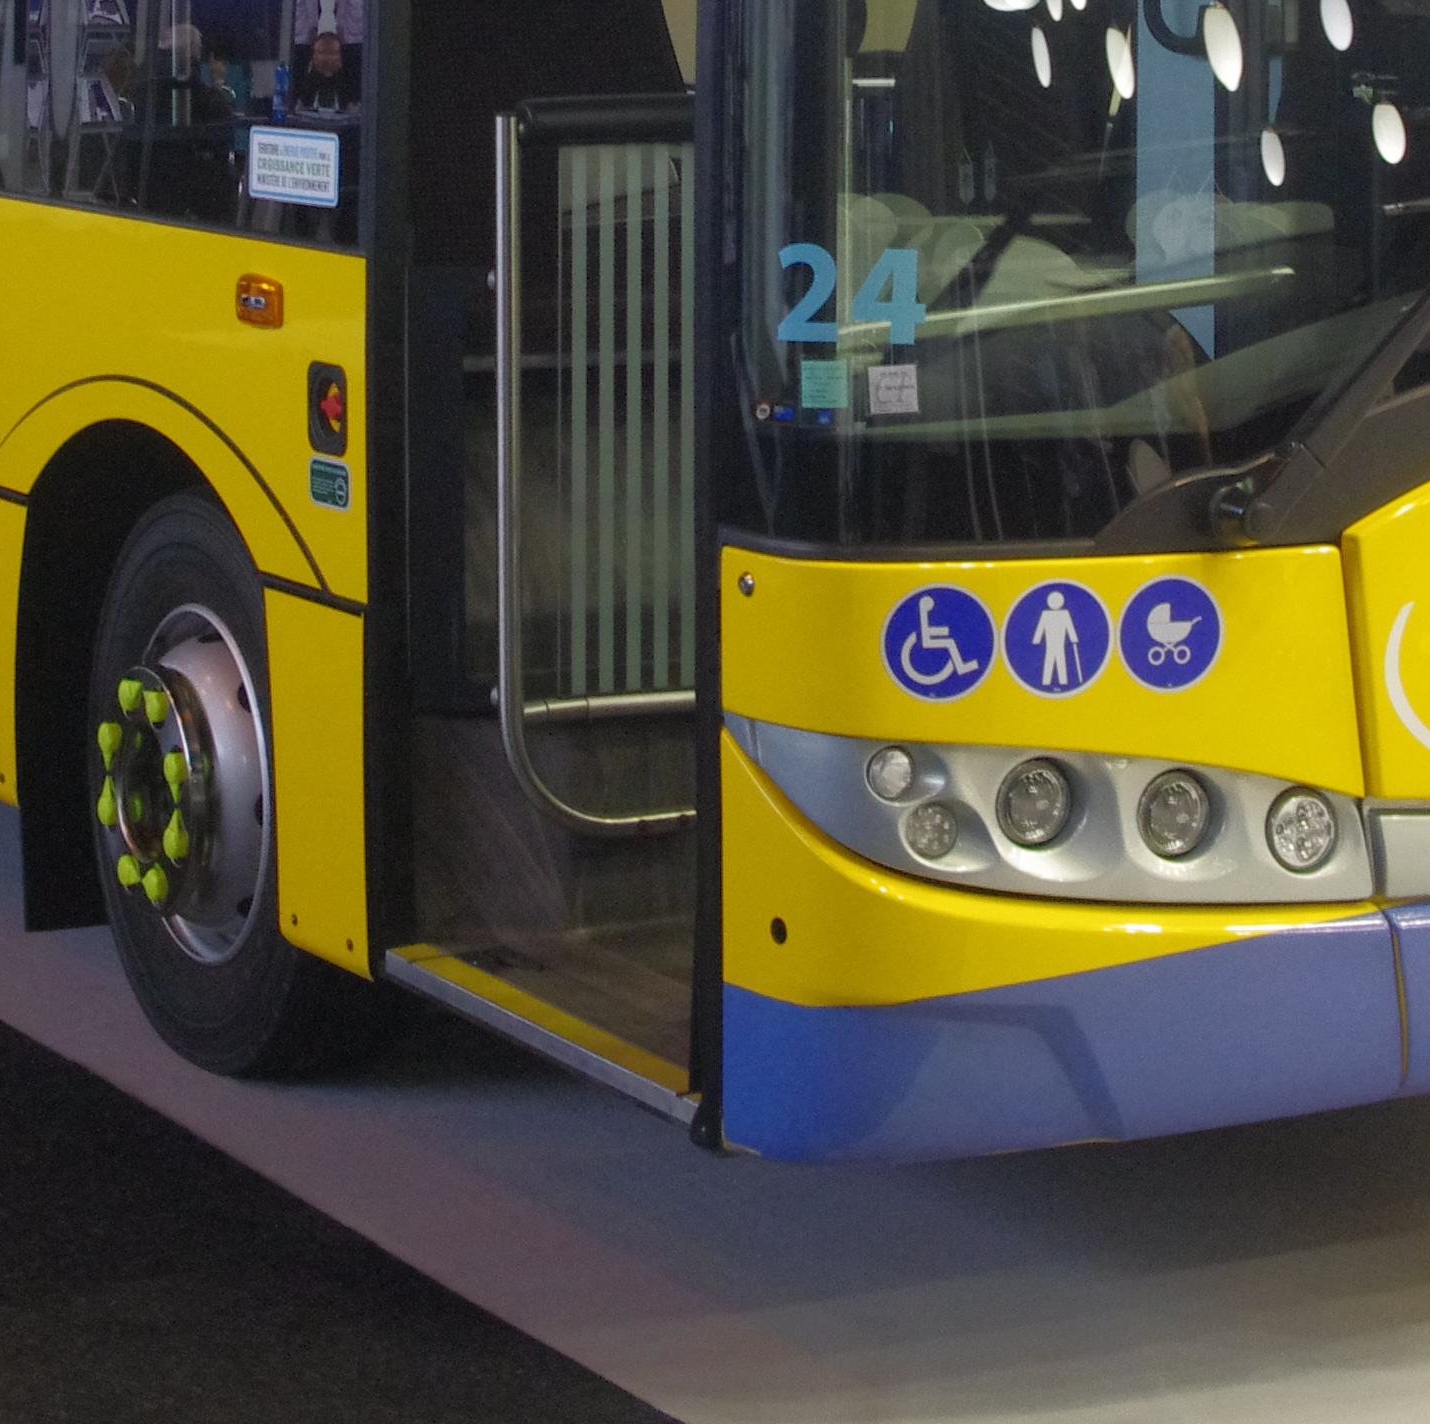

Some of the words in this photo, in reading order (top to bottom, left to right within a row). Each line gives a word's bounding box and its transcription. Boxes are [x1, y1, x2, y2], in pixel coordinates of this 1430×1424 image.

[257, 156, 305, 175] CROISSANCE
[306, 162, 330, 177] VERTE
[777, 242, 927, 346] 24
